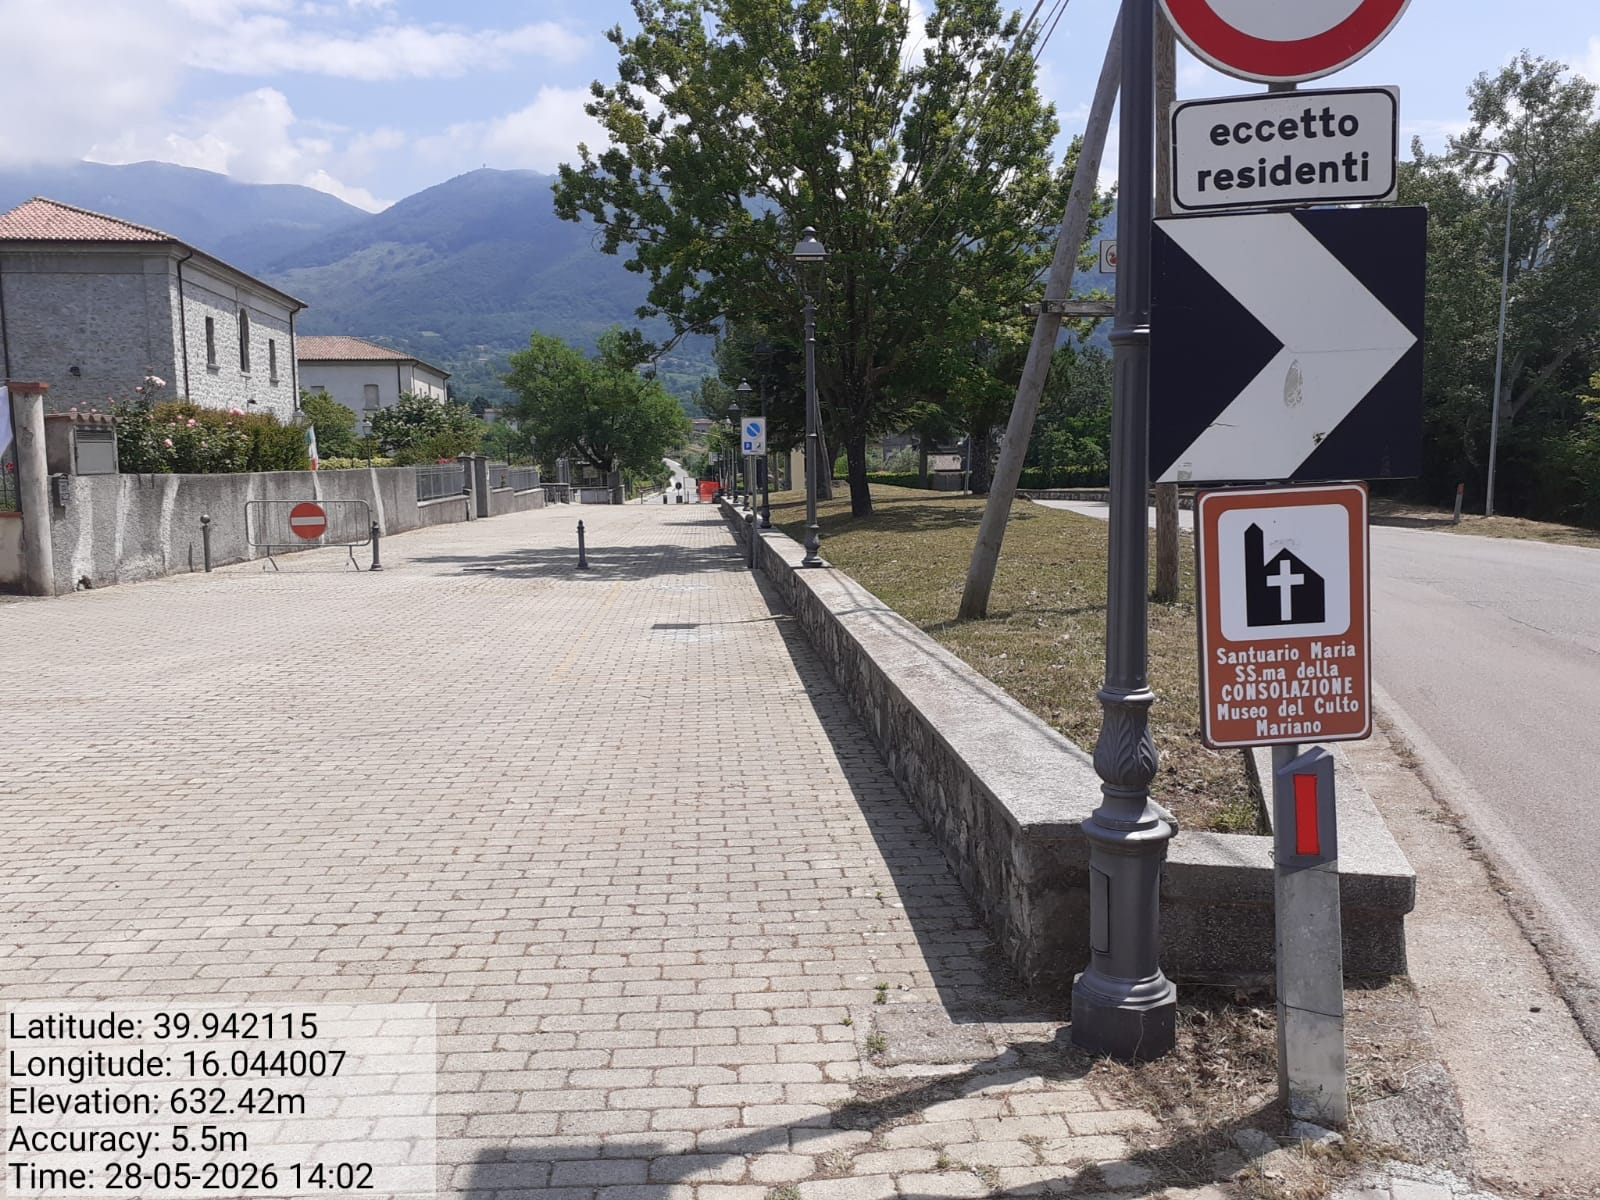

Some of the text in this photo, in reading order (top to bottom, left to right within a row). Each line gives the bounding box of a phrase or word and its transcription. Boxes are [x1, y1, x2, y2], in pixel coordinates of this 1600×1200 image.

[1209, 107, 1359, 146] eccetto
[1197, 152, 1369, 192] residenti
[1216, 640, 1356, 664] Santuario Maria
[1235, 660, 1339, 682] SS.ma della
[1221, 677, 1353, 702] CONSOLAZIONE
[1217, 696, 1359, 720] Museo del Culto
[1256, 718, 1322, 737] Mariano
